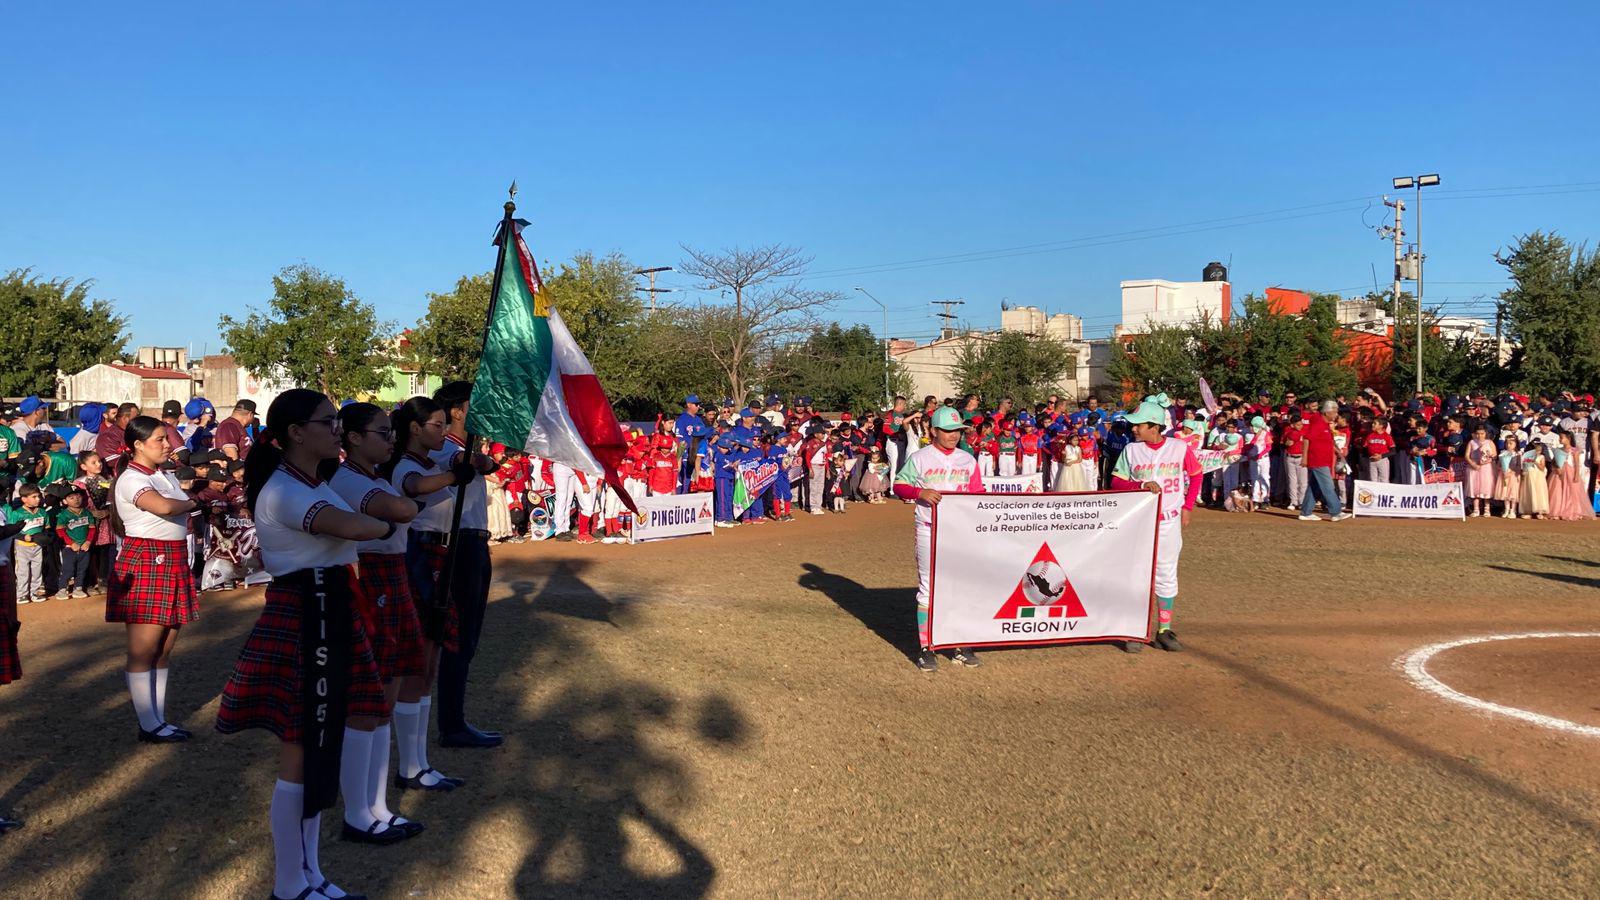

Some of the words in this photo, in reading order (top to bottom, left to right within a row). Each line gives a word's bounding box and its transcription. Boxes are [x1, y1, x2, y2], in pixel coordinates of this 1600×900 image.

[744, 462, 779, 490] Phillies
[991, 483, 1023, 492] MENOR
[1164, 478, 1180, 494] 29
[977, 501, 1029, 510] Asociacion
[1031, 500, 1045, 509] de
[1046, 501, 1072, 510] Ligas
[1073, 498, 1118, 508] Infantiles
[1377, 494, 1397, 509] INF.
[1400, 495, 1439, 509] MAYOR
[651, 505, 696, 527] PINGÜICA
[995, 514, 1002, 522] y
[1003, 512, 1048, 521] Juveniles
[1049, 511, 1062, 520] de
[1064, 511, 1100, 520] Beisbol
[975, 524, 988, 533] de
[989, 523, 999, 532] la
[1000, 523, 1049, 533] Republica
[1050, 522, 1096, 531] Mexicana
[1001, 621, 1060, 634] REGION
[1062, 620, 1079, 631] IV
